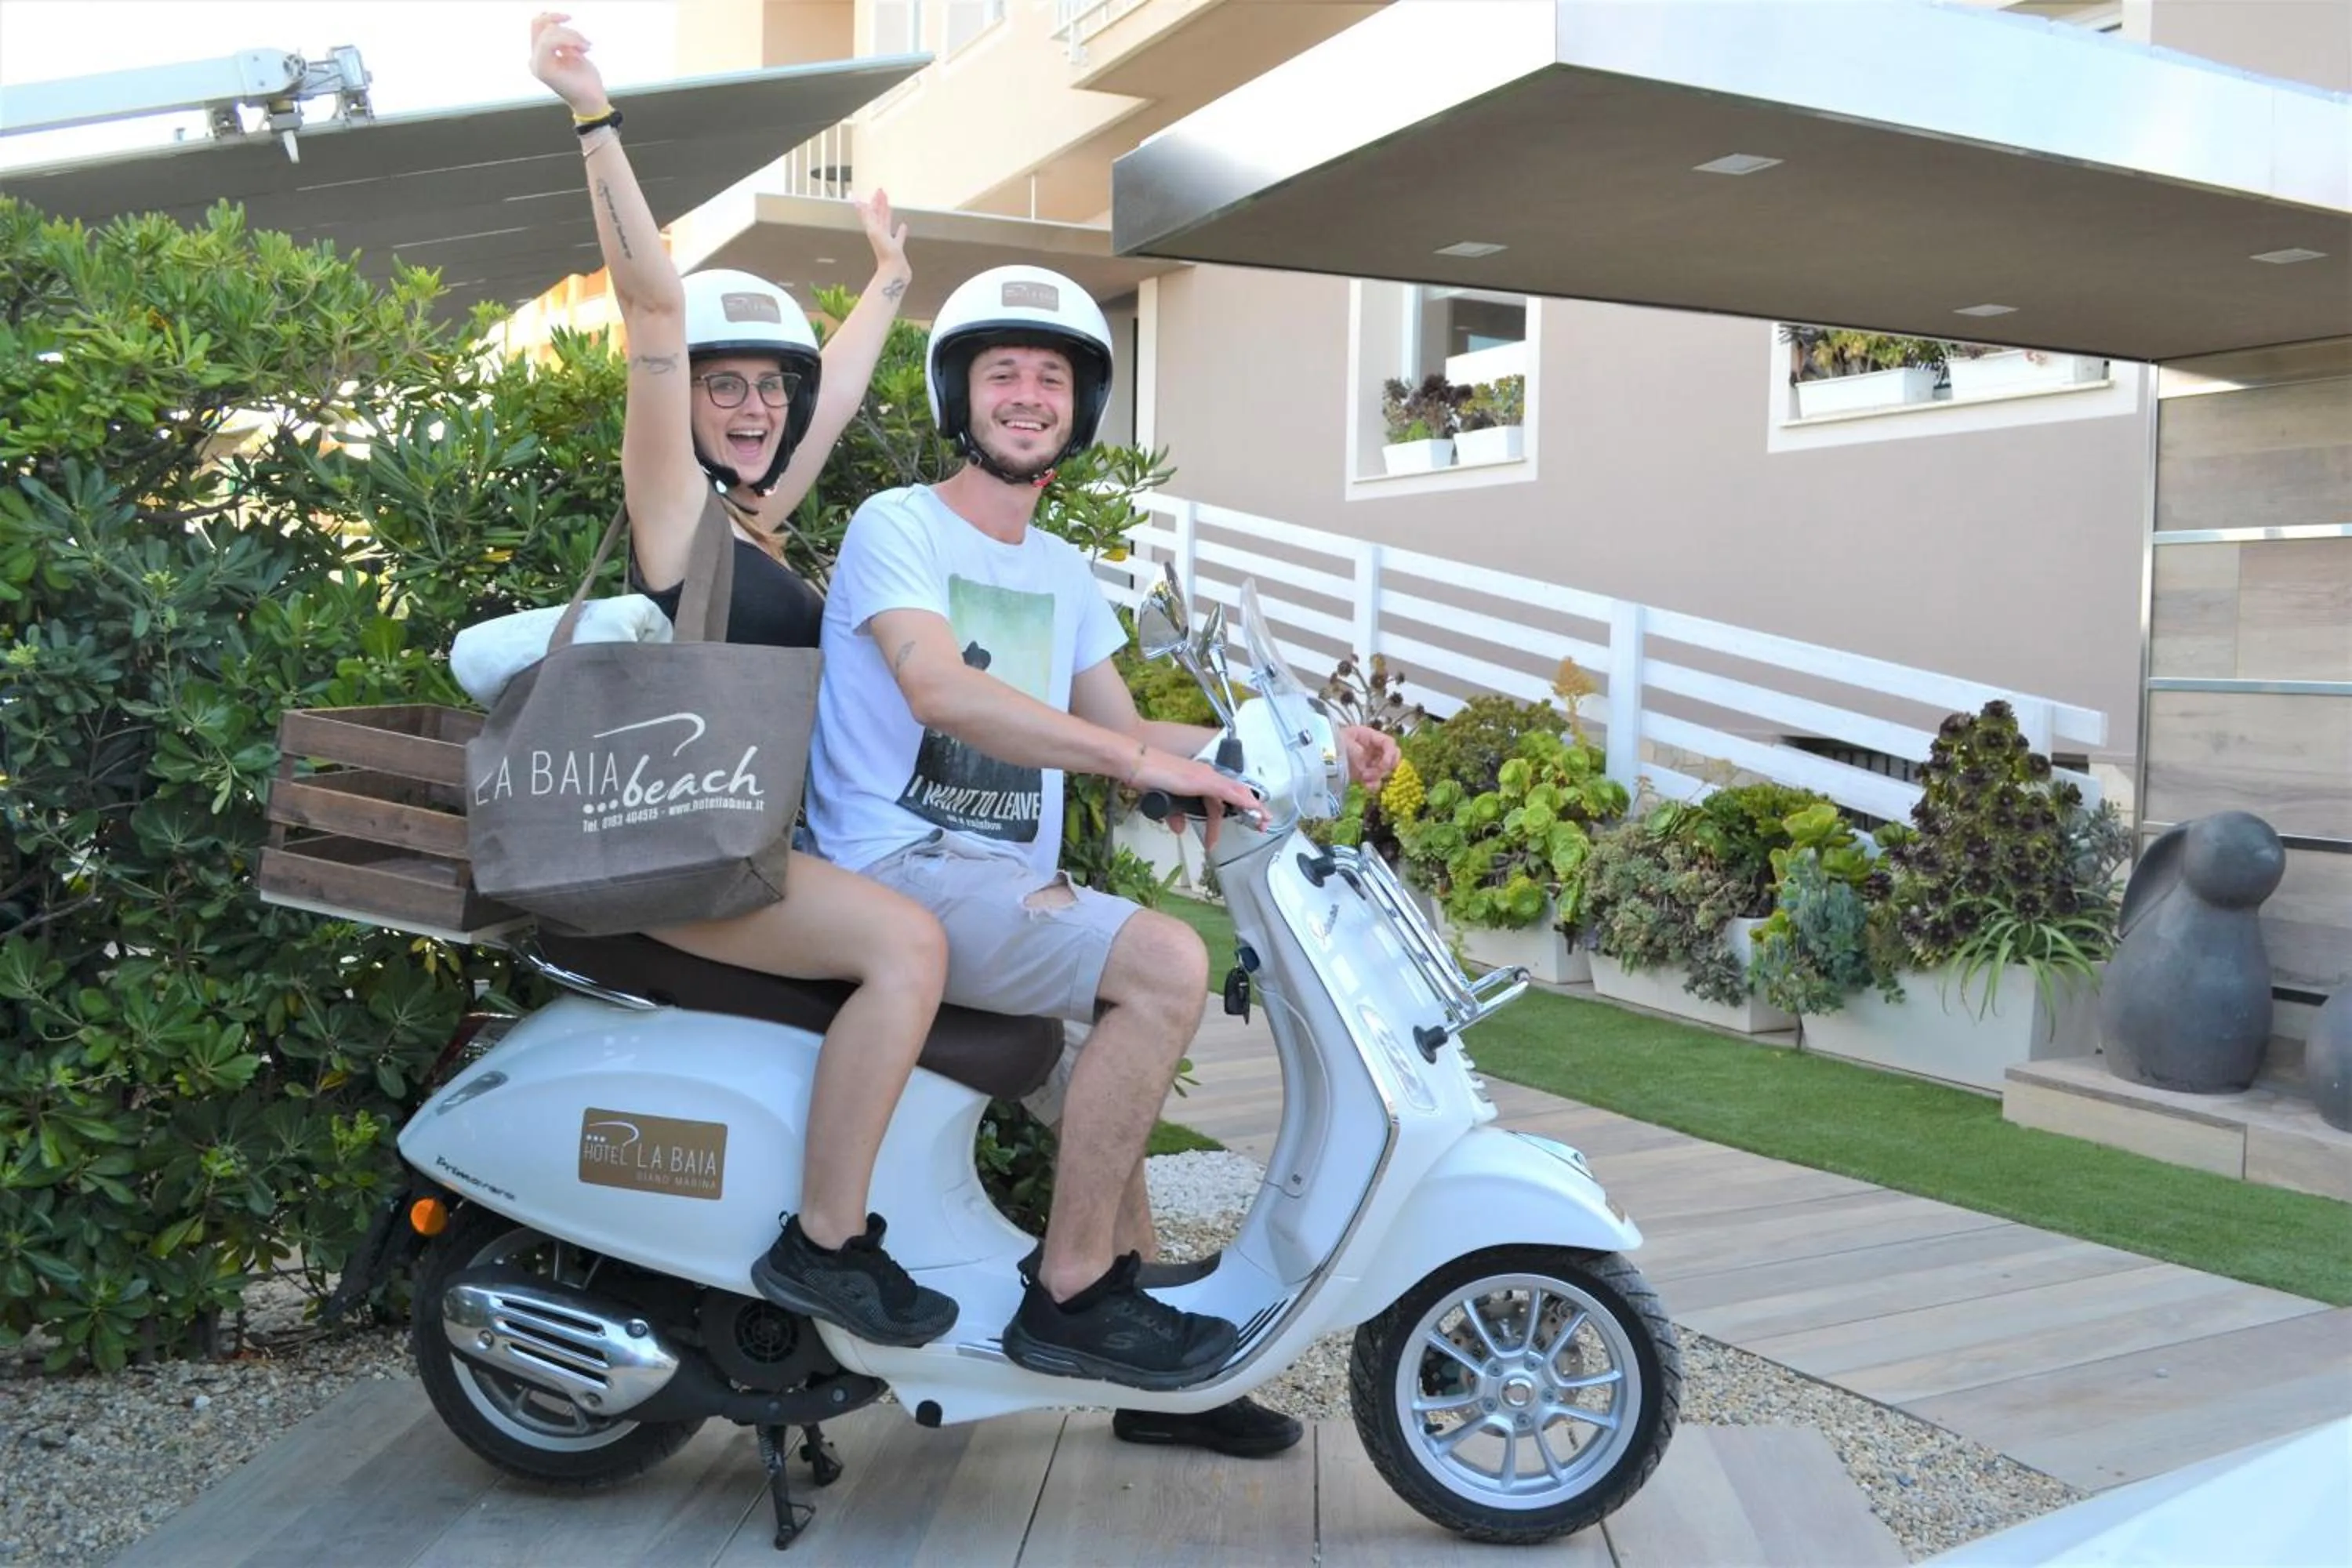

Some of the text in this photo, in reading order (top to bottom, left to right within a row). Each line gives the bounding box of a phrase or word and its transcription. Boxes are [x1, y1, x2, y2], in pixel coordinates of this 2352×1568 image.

[531, 750, 619, 796] BAIA
[908, 775, 1041, 821] I WANT TO LEAVE
[583, 1143, 717, 1176] HOTEL LA BAIA
[675, 1176, 717, 1190] MARINA
